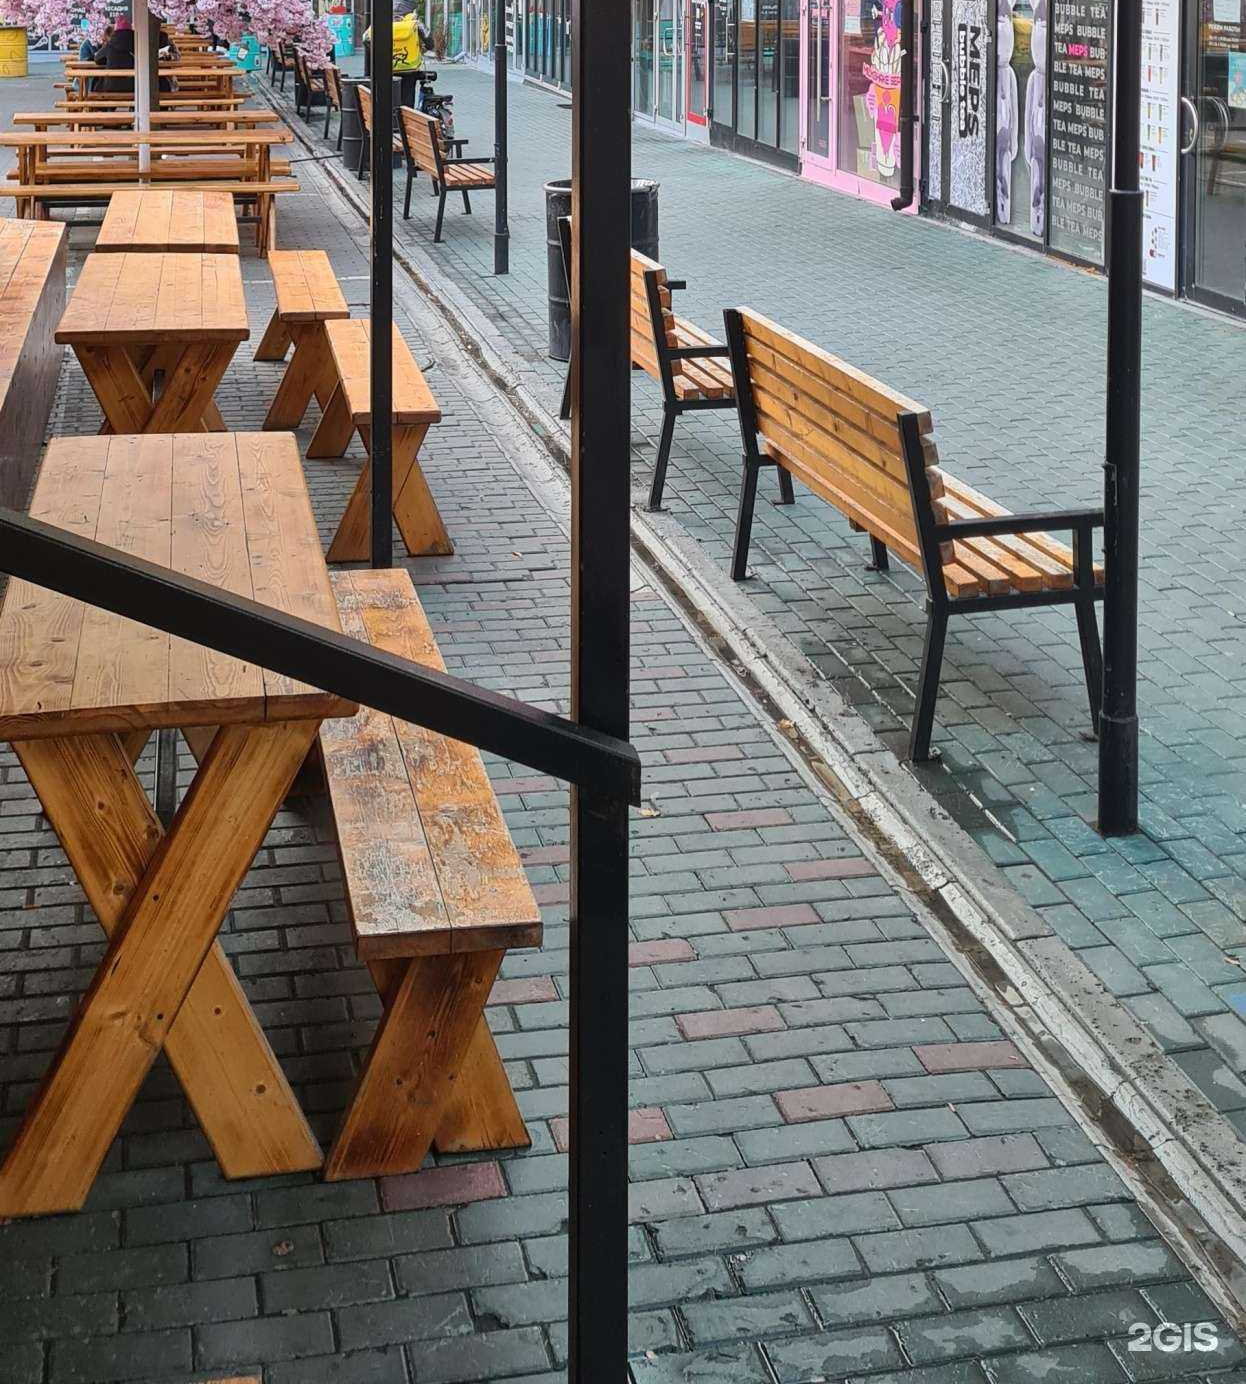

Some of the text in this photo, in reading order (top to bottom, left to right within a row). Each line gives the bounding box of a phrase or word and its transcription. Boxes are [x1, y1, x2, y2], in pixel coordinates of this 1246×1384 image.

[1055, 3, 1106, 18] BUBBLE TEA
[1055, 24, 1106, 38] MEPS BUBBLE
[1054, 42, 1105, 59] TEA MEPS BUB
[959, 30, 967, 97] bubble
[1054, 61, 1105, 80] BLE TEA MEPS
[968, 25, 981, 137] MEPS
[1053, 81, 1105, 100] BUBBLE TEA
[1053, 100, 1105, 121] MEPS BUBBLE
[1053, 119, 1104, 141] TEA MEPS BUB
[1053, 138, 1104, 161] BLE TEA MEPS
[1053, 158, 1104, 182] BUBBLE TEA
[1052, 177, 1103, 201] MEPS BUBBLE
[1052, 196, 1103, 220] TEA MEPS BUB
[1052, 216, 1103, 241] BLE TEA MEPS
